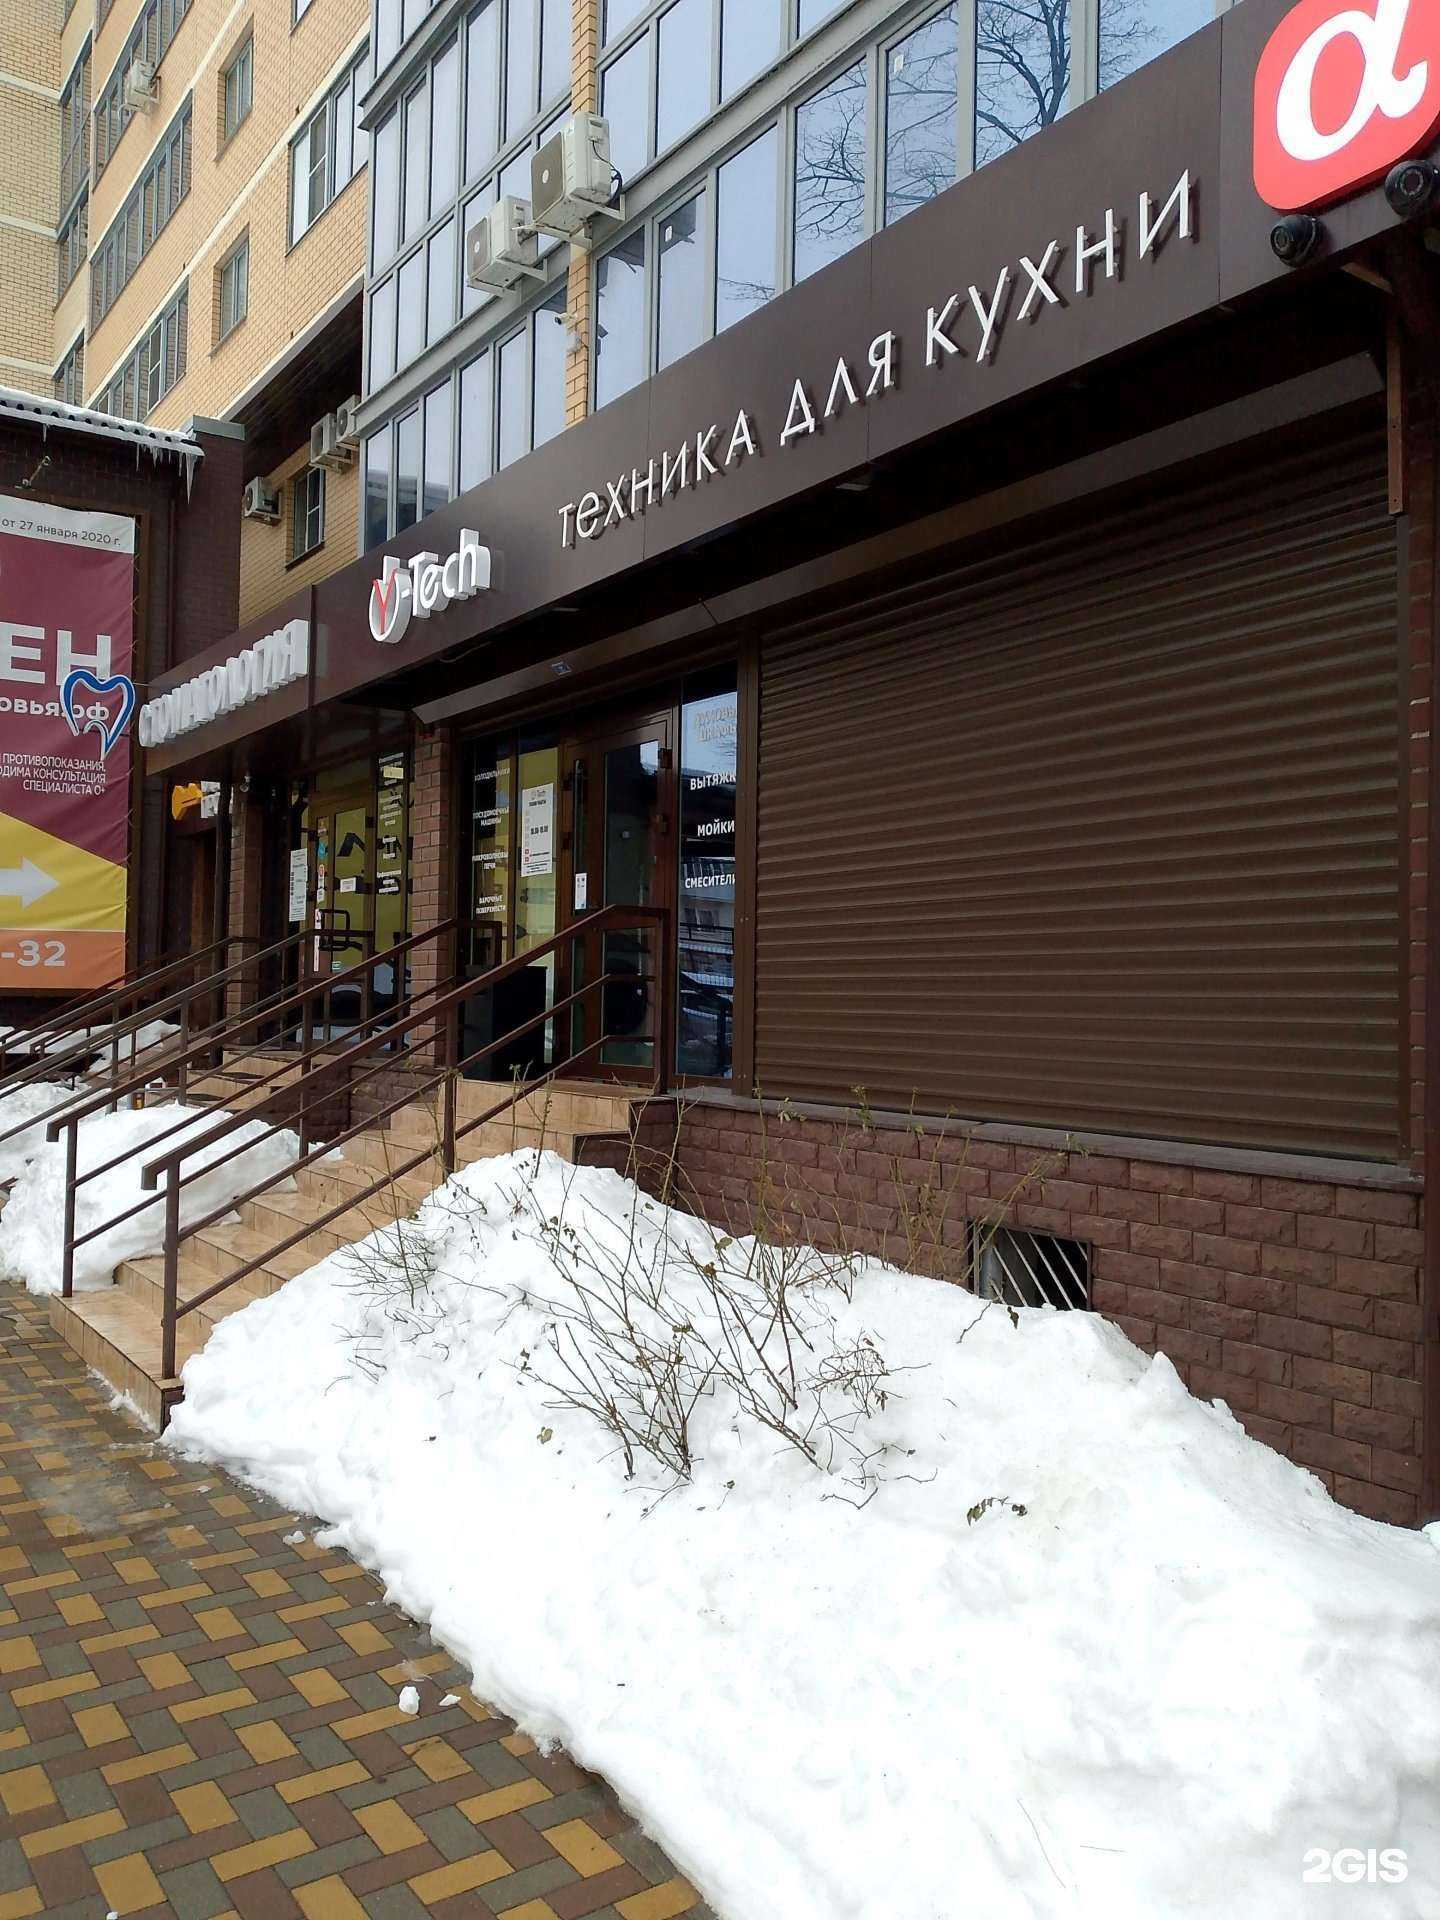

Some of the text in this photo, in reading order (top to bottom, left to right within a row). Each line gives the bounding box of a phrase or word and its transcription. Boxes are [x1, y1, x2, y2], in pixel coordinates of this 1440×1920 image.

[780, 331, 897, 446] ДЛЯ
[926, 169, 1189, 366] КУХНИ
[1, 519, 16, 528] от
[20, 520, 33, 531] 27
[36, 525, 79, 539] января
[81, 531, 111, 544] 2020
[33, 768, 106, 785] КОНСУЛЬТАЦИЯ
[23, 779, 92, 795] СПЕЦИАЛИСТА
[697, 819, 735, 837] МОЙКИ
